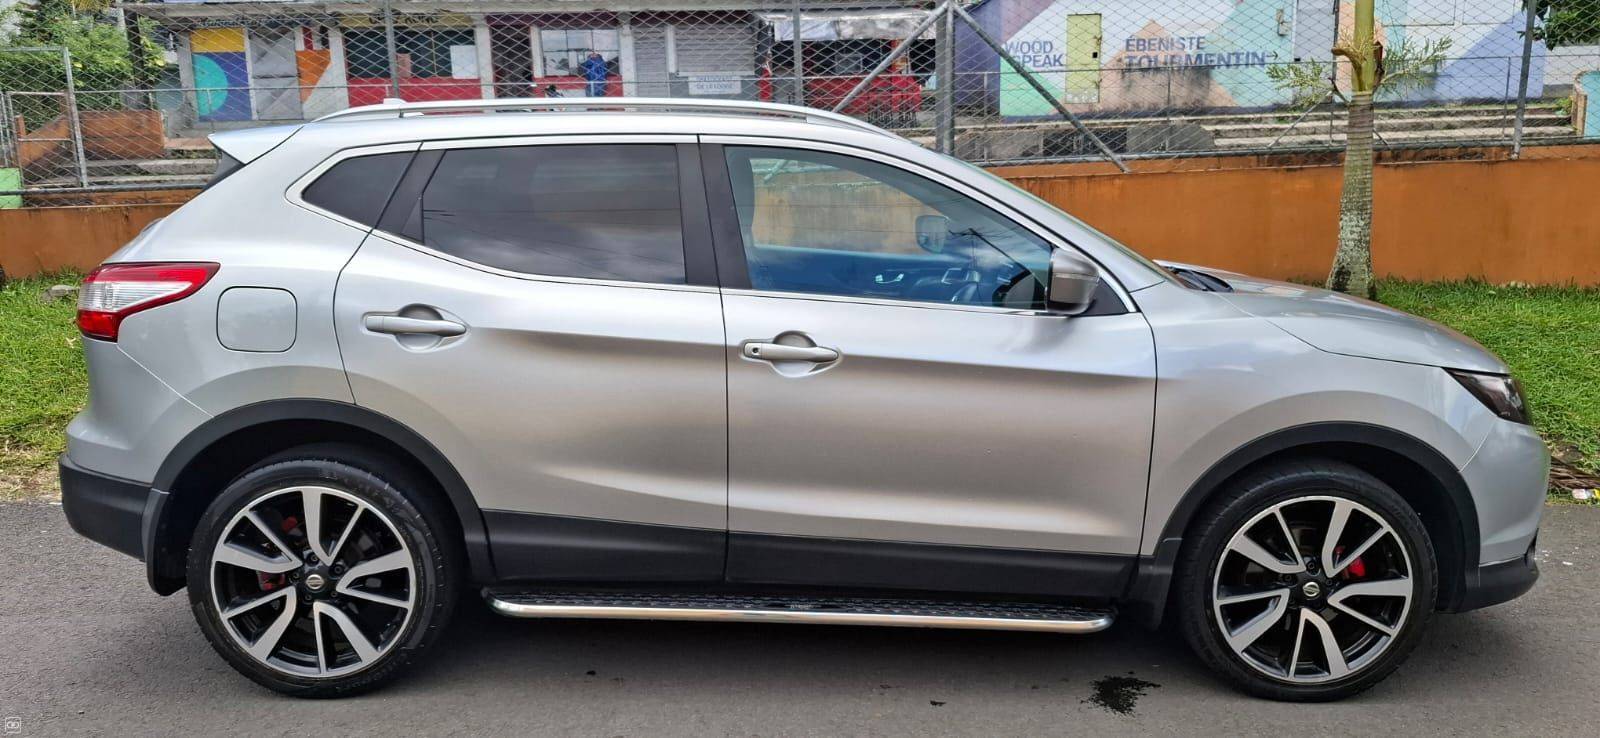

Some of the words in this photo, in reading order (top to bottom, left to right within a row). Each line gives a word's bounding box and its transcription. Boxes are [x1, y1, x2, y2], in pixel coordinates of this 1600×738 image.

[1004, 41, 1053, 54] WOOD
[1125, 36, 1206, 52] ÉBENISTE
[1124, 51, 1266, 69] TOURMENTIN
